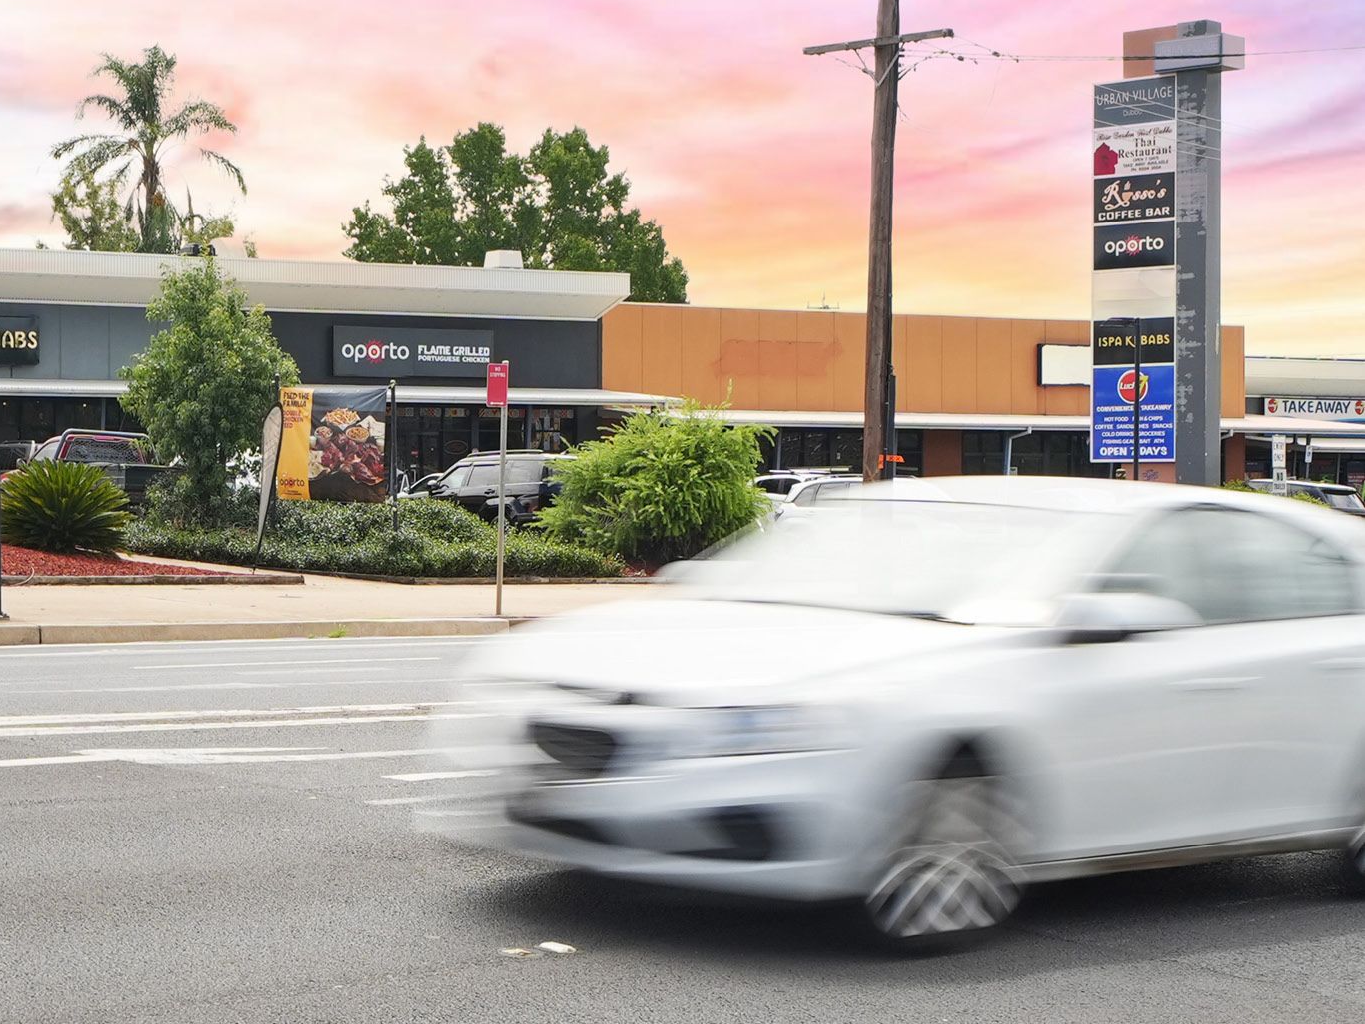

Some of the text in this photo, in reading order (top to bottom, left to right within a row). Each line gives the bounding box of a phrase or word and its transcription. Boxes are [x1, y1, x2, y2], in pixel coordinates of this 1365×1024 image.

[1096, 86, 1173, 106] URBAN VILLAGE
[1133, 136, 1156, 148] Thai
[1118, 145, 1172, 159] Restaurant
[1098, 206, 1171, 221] COFFEE BAR
[1104, 235, 1165, 257] oporto
[1098, 333, 1171, 348] ISPA KBABS
[341, 342, 491, 364] oporto FLAME GRILLED
[417, 355, 491, 364] PORTUGUESE CHICKEN
[1282, 400, 1351, 414] TAKEAWAY
[1099, 446, 1128, 456] OPEN
[1139, 446, 1168, 456] DAYS
